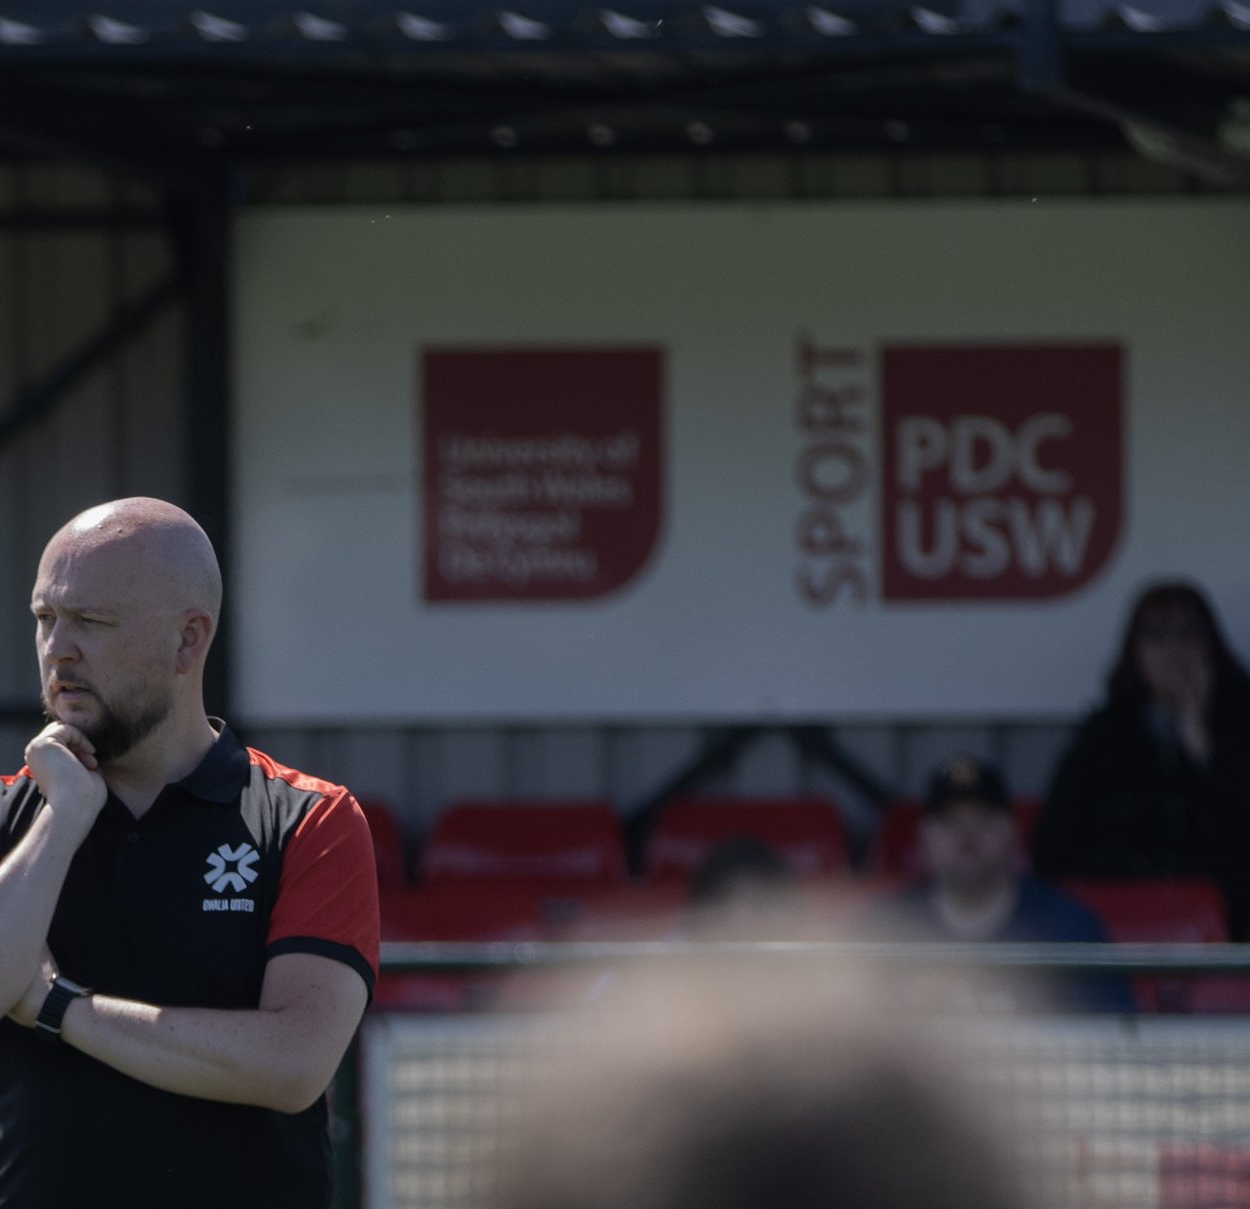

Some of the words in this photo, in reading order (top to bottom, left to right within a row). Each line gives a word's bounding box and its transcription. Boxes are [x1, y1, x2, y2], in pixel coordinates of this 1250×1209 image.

[797, 331, 867, 609] SPORT
[895, 412, 1074, 495] PDC
[896, 495, 1096, 578] USW
